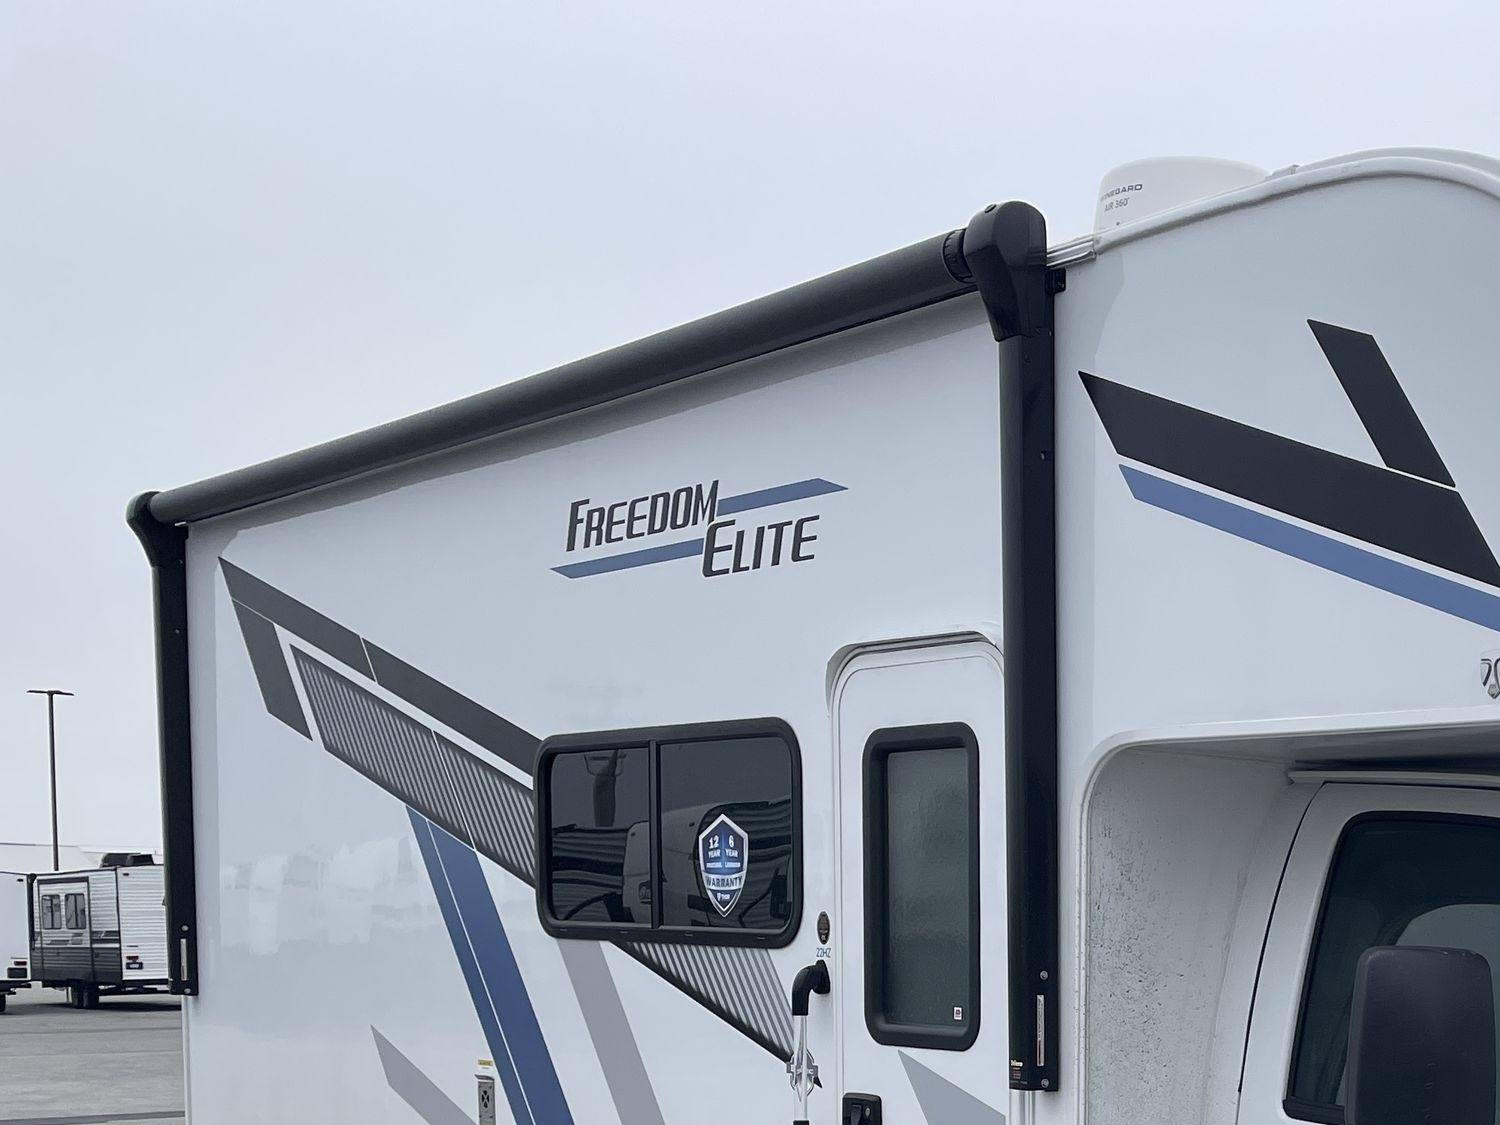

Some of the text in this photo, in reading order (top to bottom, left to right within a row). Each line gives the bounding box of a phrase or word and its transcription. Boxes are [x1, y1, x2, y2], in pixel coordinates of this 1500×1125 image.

[566, 479, 719, 552] FREEDOM
[702, 515, 820, 578] ELITE
[708, 835, 719, 849] 12
[728, 834, 735, 848] 6
[708, 849, 721, 858] YEAR
[725, 848, 738, 858] YEAR
[705, 875, 743, 888] WARRANTY
